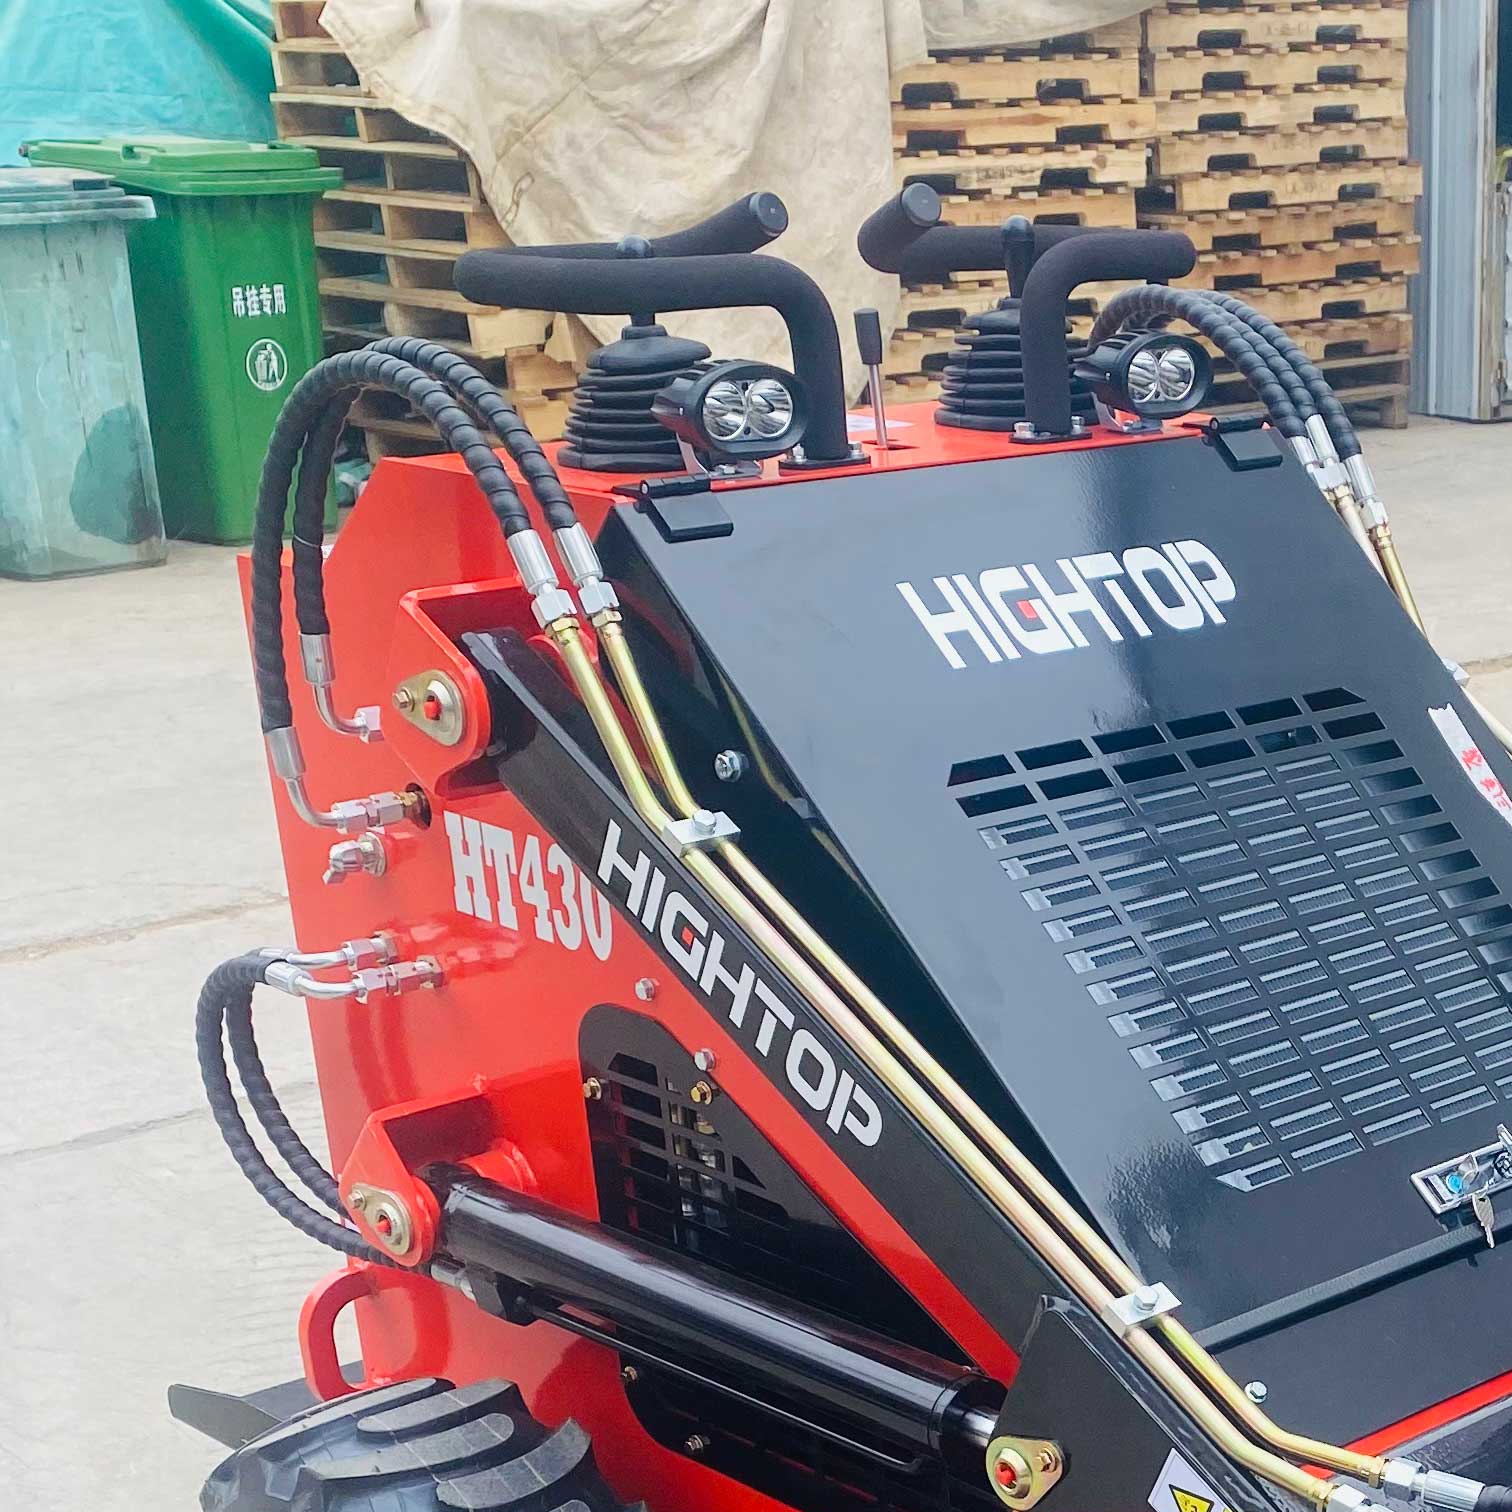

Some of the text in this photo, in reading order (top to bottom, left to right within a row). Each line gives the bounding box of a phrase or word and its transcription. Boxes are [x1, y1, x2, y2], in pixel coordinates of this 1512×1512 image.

[232, 283, 287, 318] 吊挂专用
[895, 539, 1236, 670] HIGHTOP
[443, 811, 613, 962] HT430
[597, 818, 883, 1147] HIGHTOP
